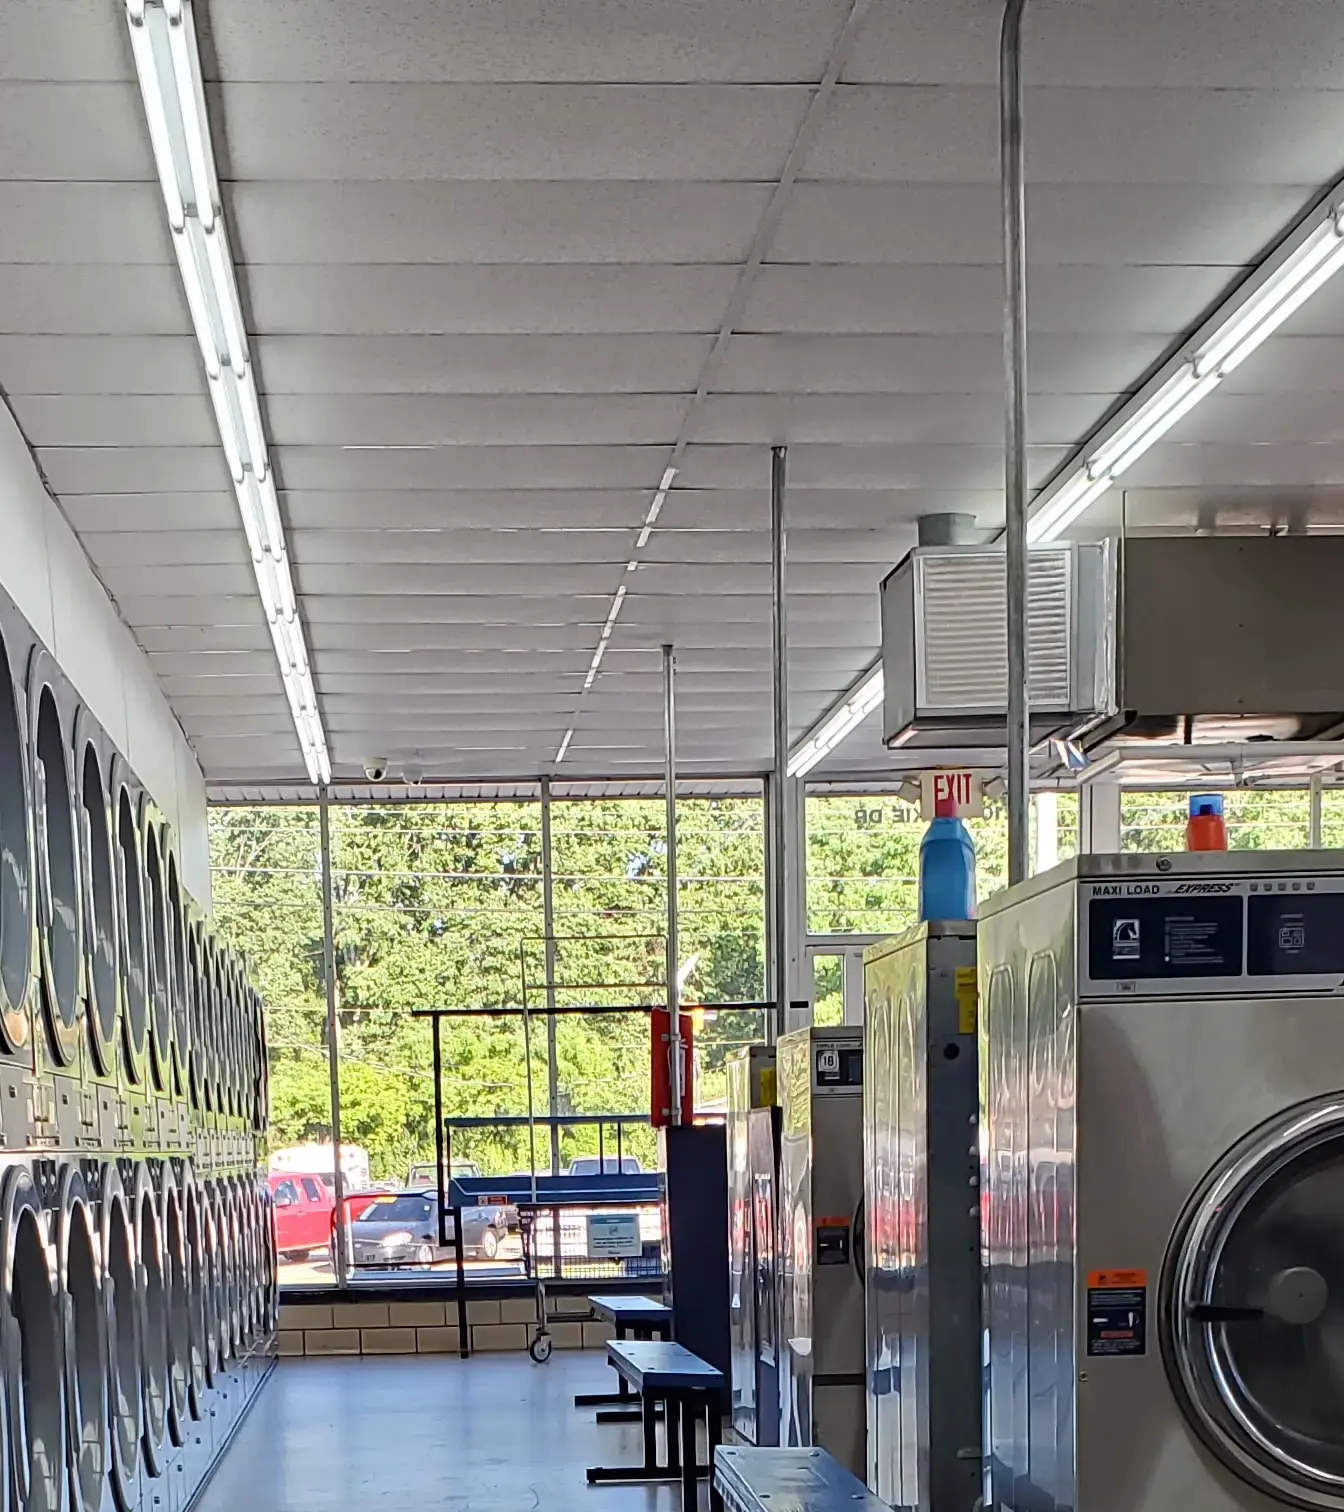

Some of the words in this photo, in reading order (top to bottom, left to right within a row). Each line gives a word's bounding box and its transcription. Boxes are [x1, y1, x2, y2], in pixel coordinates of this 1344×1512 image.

[934, 772, 973, 804] EXIT
[1092, 886, 1122, 896] MAXI
[1126, 885, 1160, 895] LOAD
[1174, 883, 1234, 893] EXPRESS
[824, 1055, 834, 1066] 18
